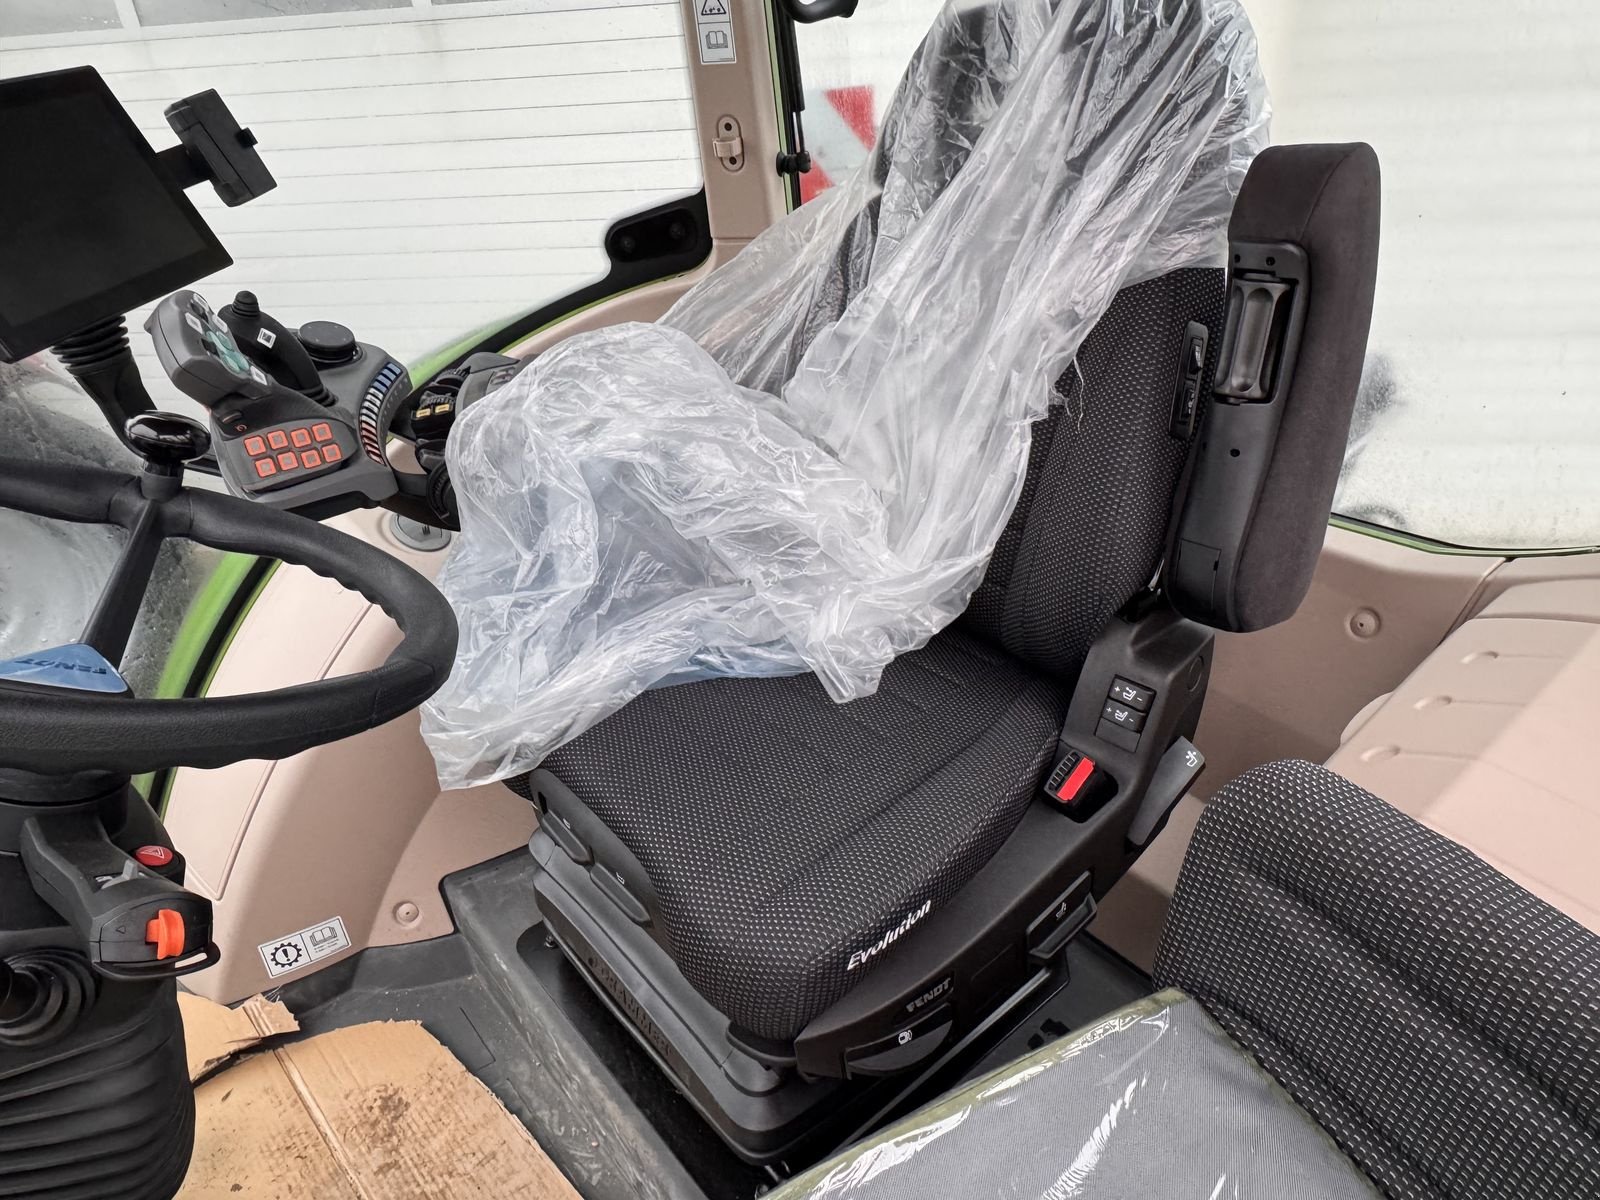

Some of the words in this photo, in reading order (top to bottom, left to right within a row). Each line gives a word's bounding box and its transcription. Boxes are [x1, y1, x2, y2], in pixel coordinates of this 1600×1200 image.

[15, 658, 107, 674] FENDT
[847, 900, 931, 971] Evolution
[906, 978, 951, 1012] FENDT
